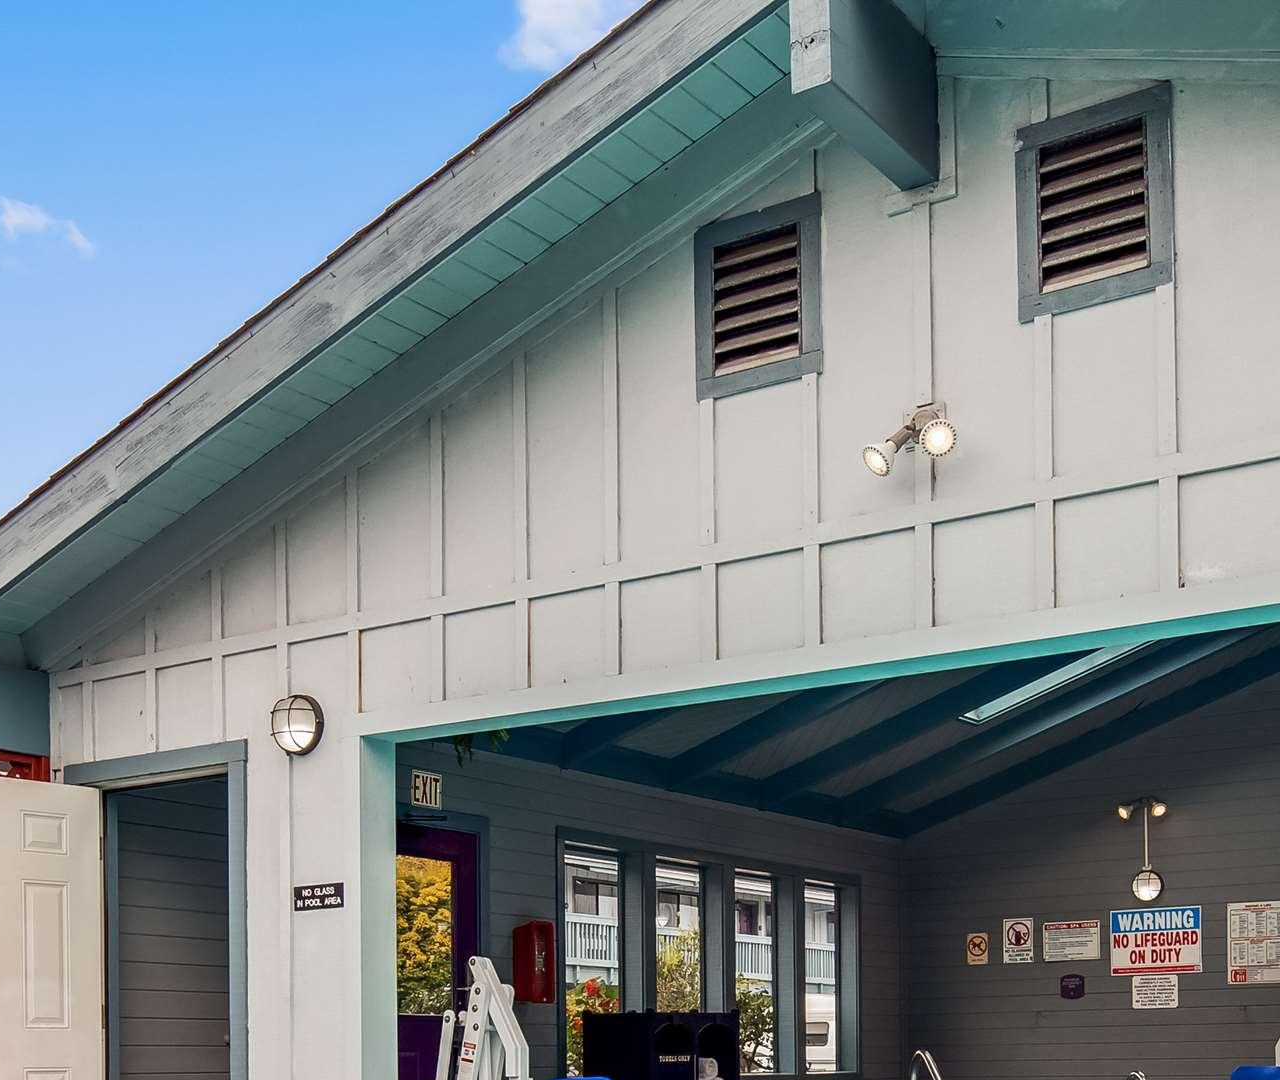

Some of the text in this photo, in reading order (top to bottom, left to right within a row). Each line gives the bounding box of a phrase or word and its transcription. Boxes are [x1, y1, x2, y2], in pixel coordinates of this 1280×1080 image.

[414, 774, 440, 806] EXIT
[302, 887, 335, 897] NO GLASS
[297, 897, 341, 908] IN POOL AREA
[1118, 910, 1194, 931] WARNING
[1113, 934, 1129, 949] NO
[1134, 930, 1198, 947] LIFEGUARD
[1130, 948, 1181, 964] ON DUTY
